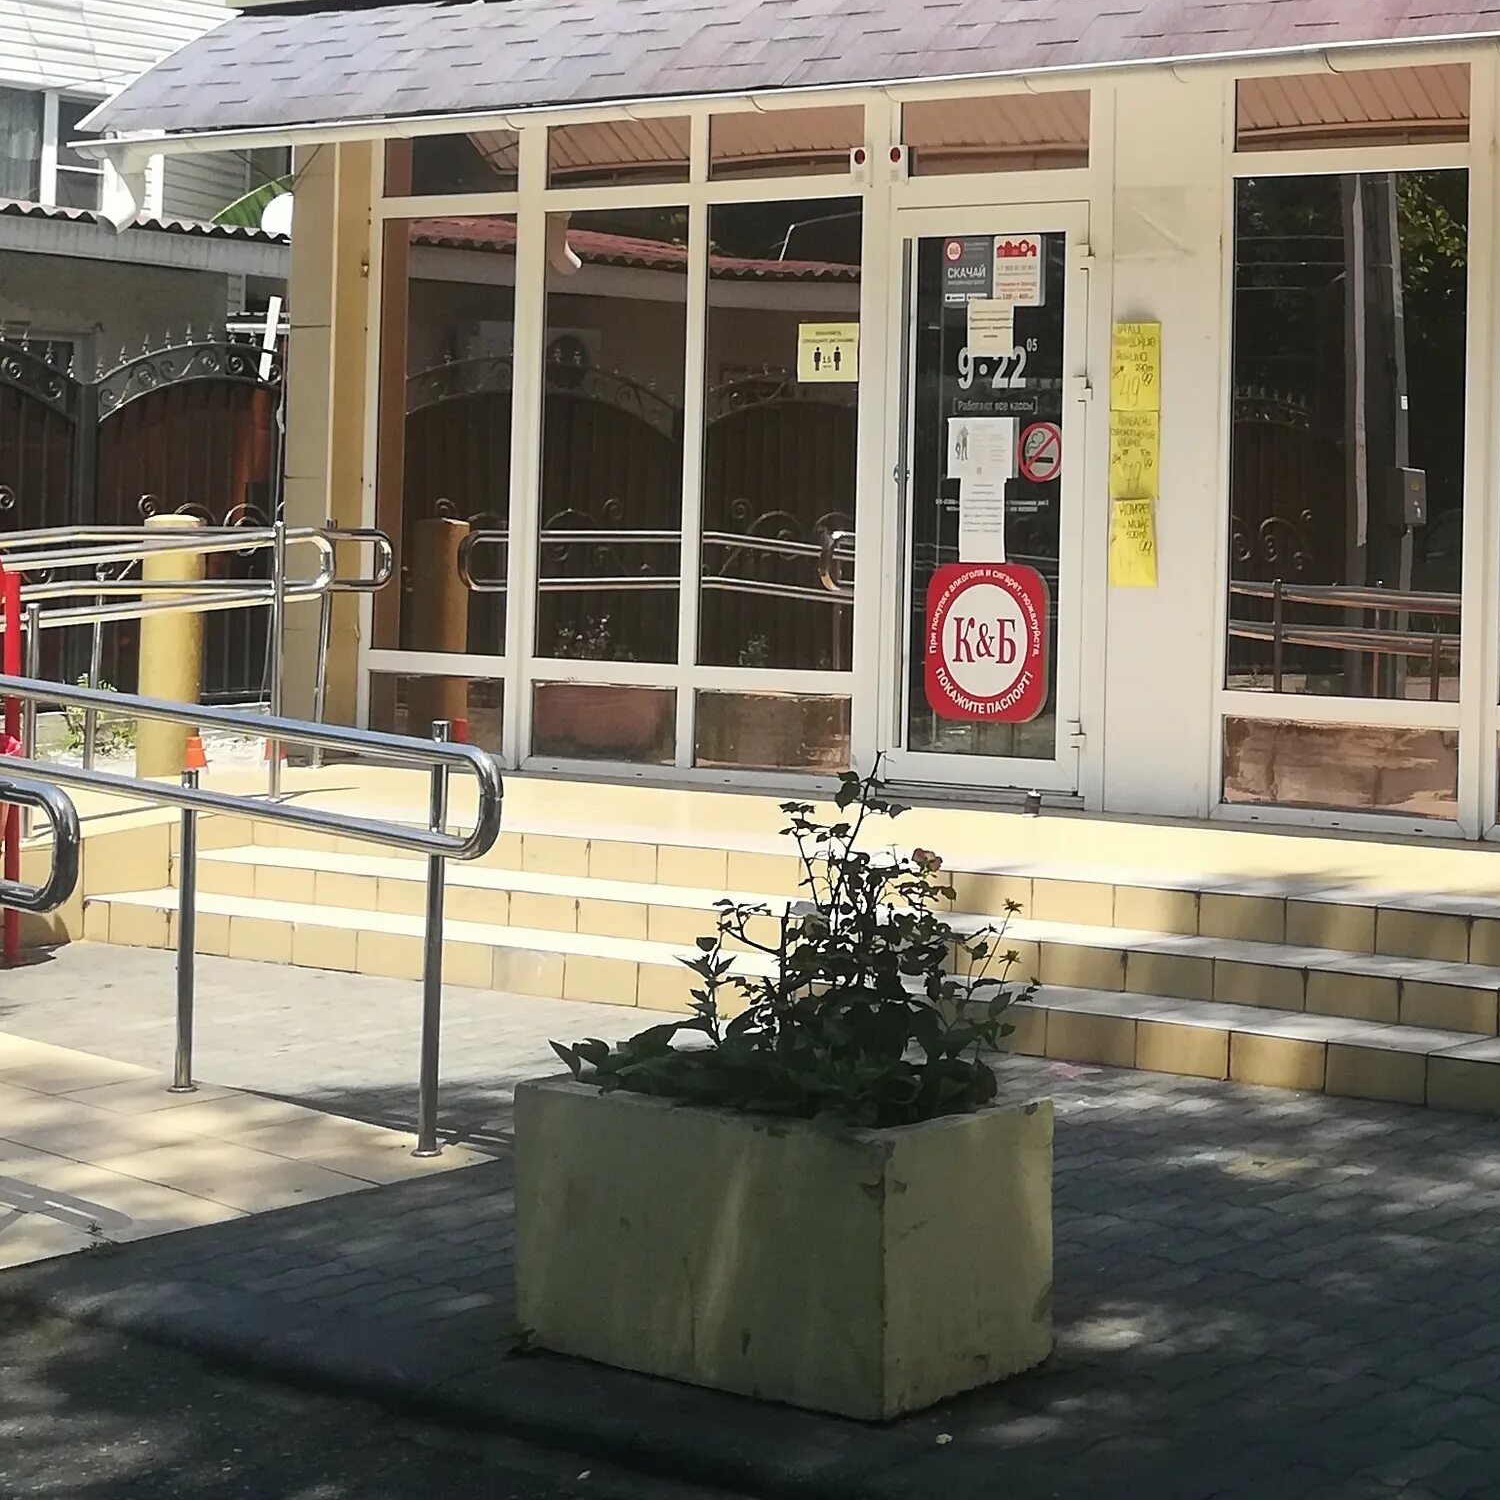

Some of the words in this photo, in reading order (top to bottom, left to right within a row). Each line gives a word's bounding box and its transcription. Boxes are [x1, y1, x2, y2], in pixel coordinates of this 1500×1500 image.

[947, 264, 987, 279] СКАЧАЙ
[948, 569, 985, 592] алкоголя
[931, 590, 951, 632] покупке
[929, 632, 938, 655] При
[951, 616, 1017, 665] К&Б
[935, 666, 986, 715] ПОКАЖИТЕ
[986, 670, 1034, 715] ПАСПОРТ!
